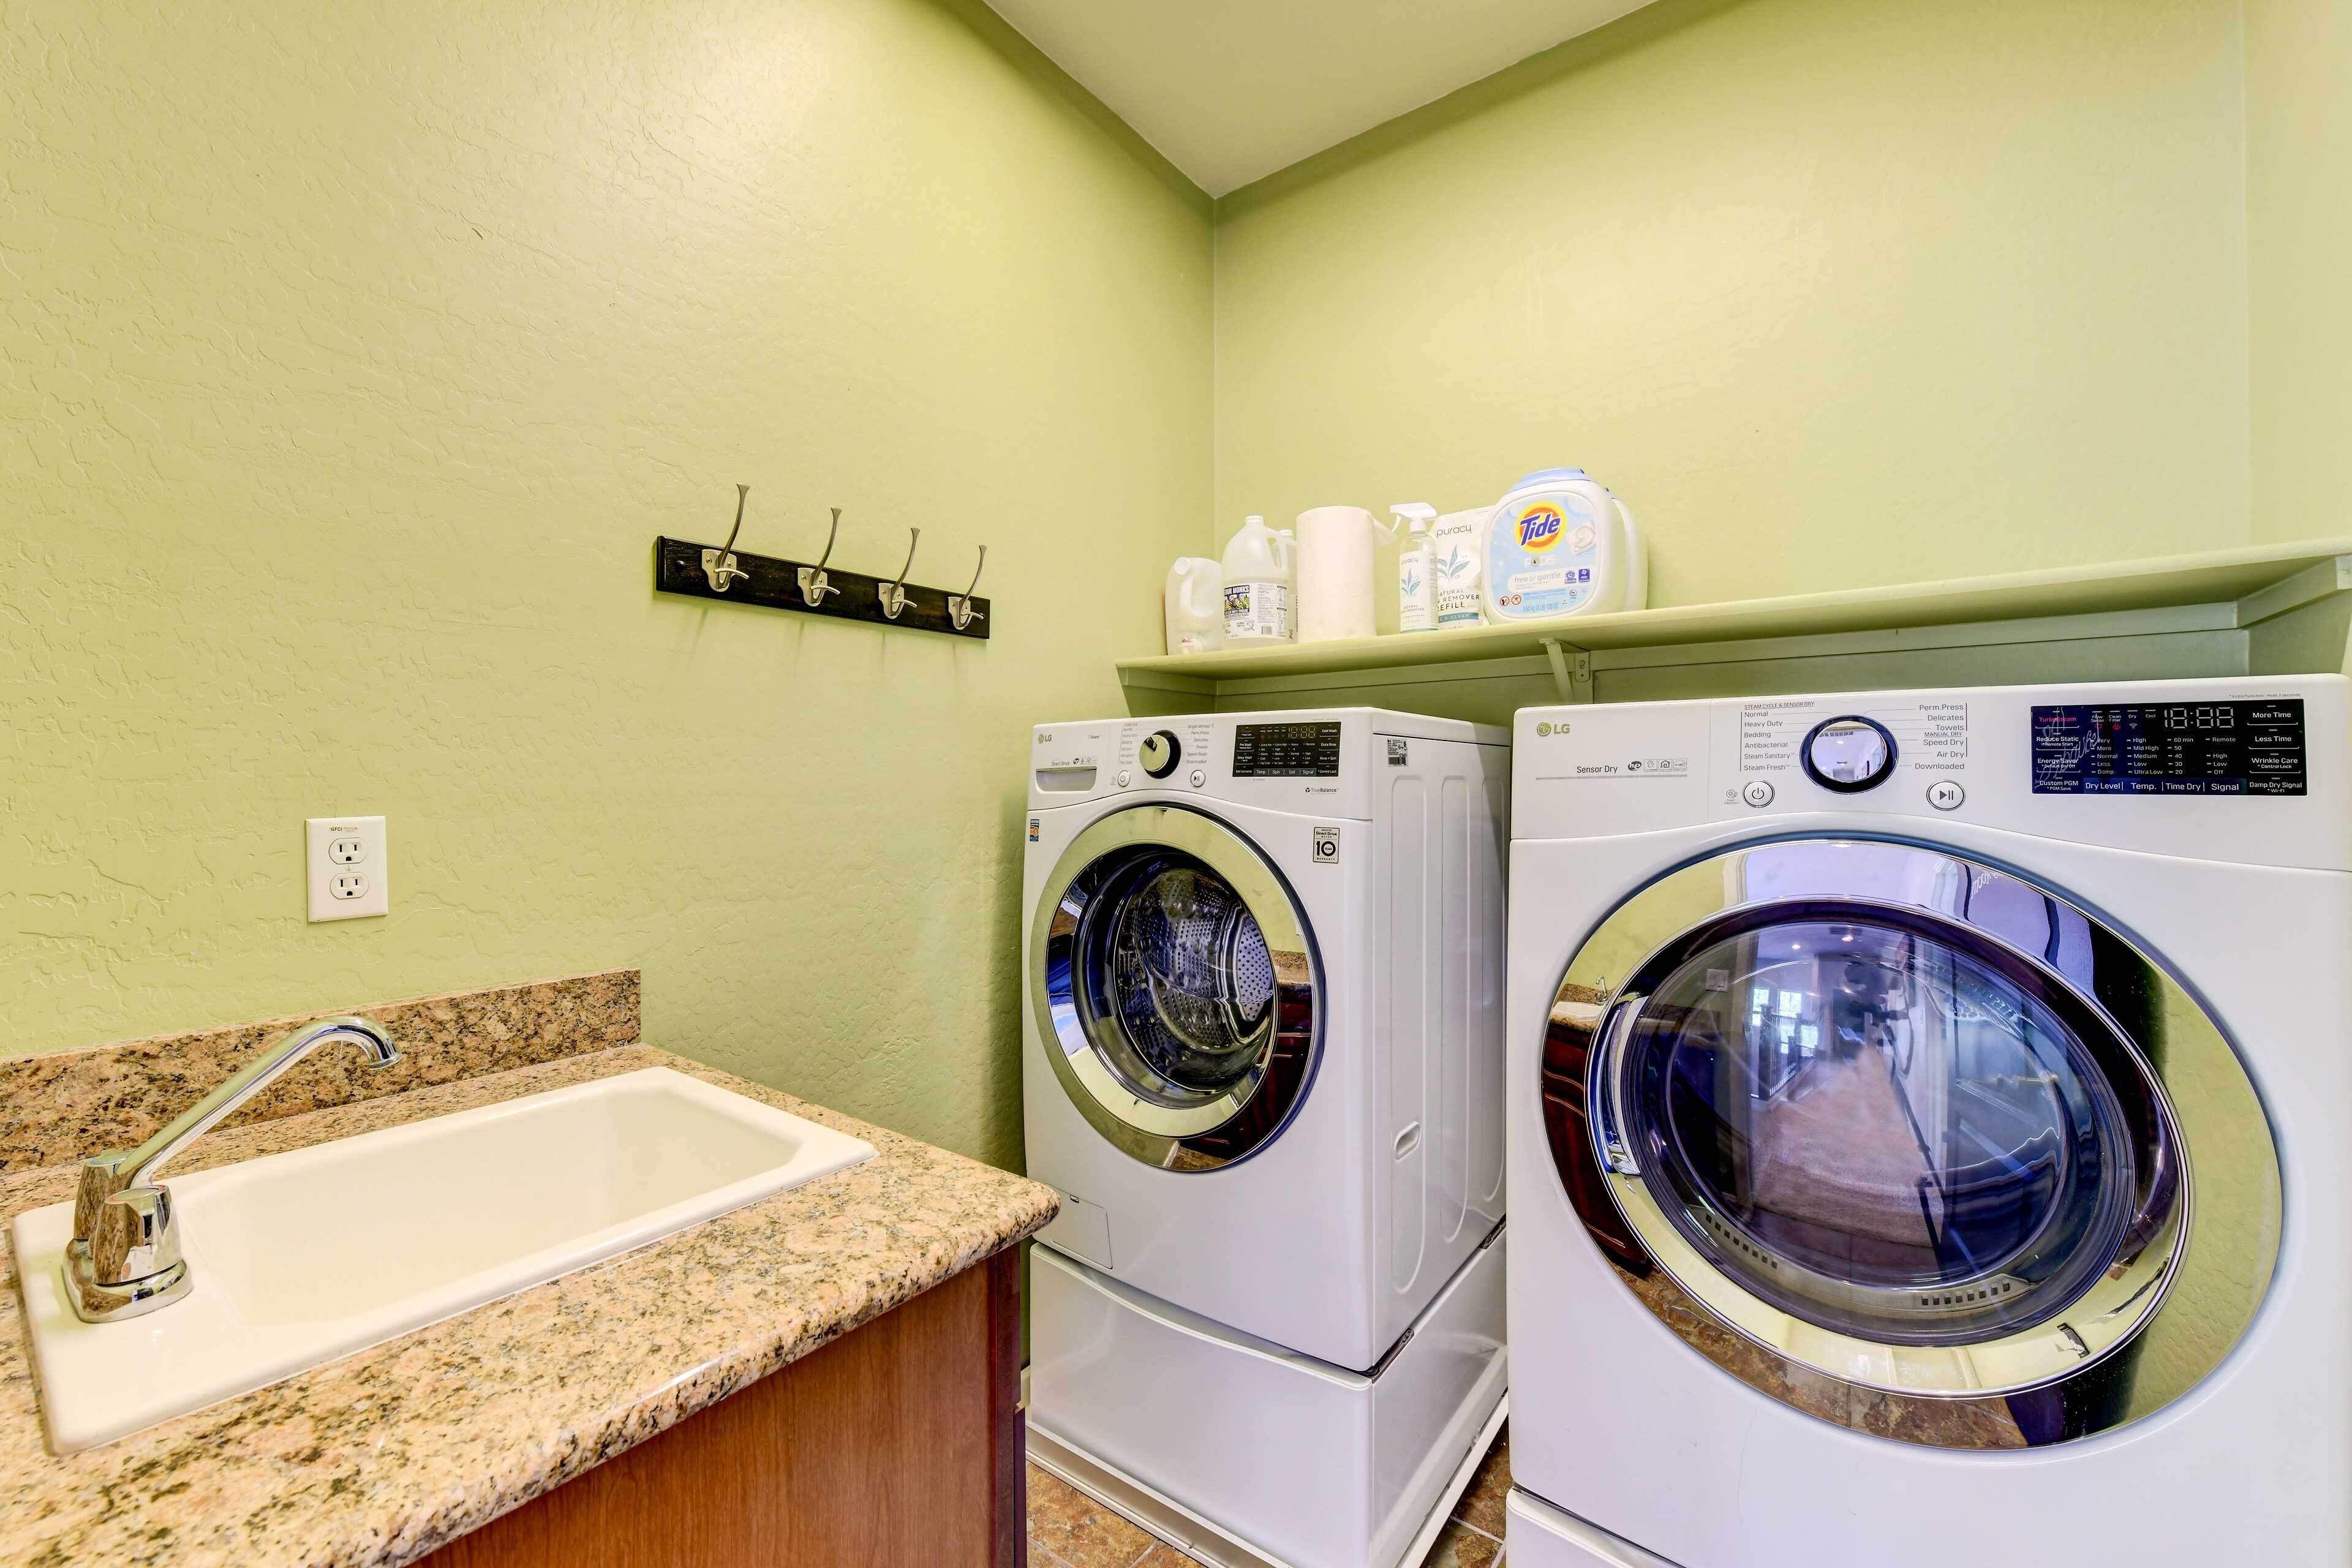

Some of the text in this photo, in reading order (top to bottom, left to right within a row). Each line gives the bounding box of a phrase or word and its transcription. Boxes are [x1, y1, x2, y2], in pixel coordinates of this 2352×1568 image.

[1436, 524, 1471, 538] puracy
[1520, 513, 1561, 546] Tide
[1537, 572, 1561, 581] gentle
[1553, 723, 1570, 734] LG
[1604, 765, 1618, 774] Dry
[2130, 782, 2157, 791] Temp.
[2187, 783, 2201, 791] Dry
[1316, 841, 1336, 856] 10
